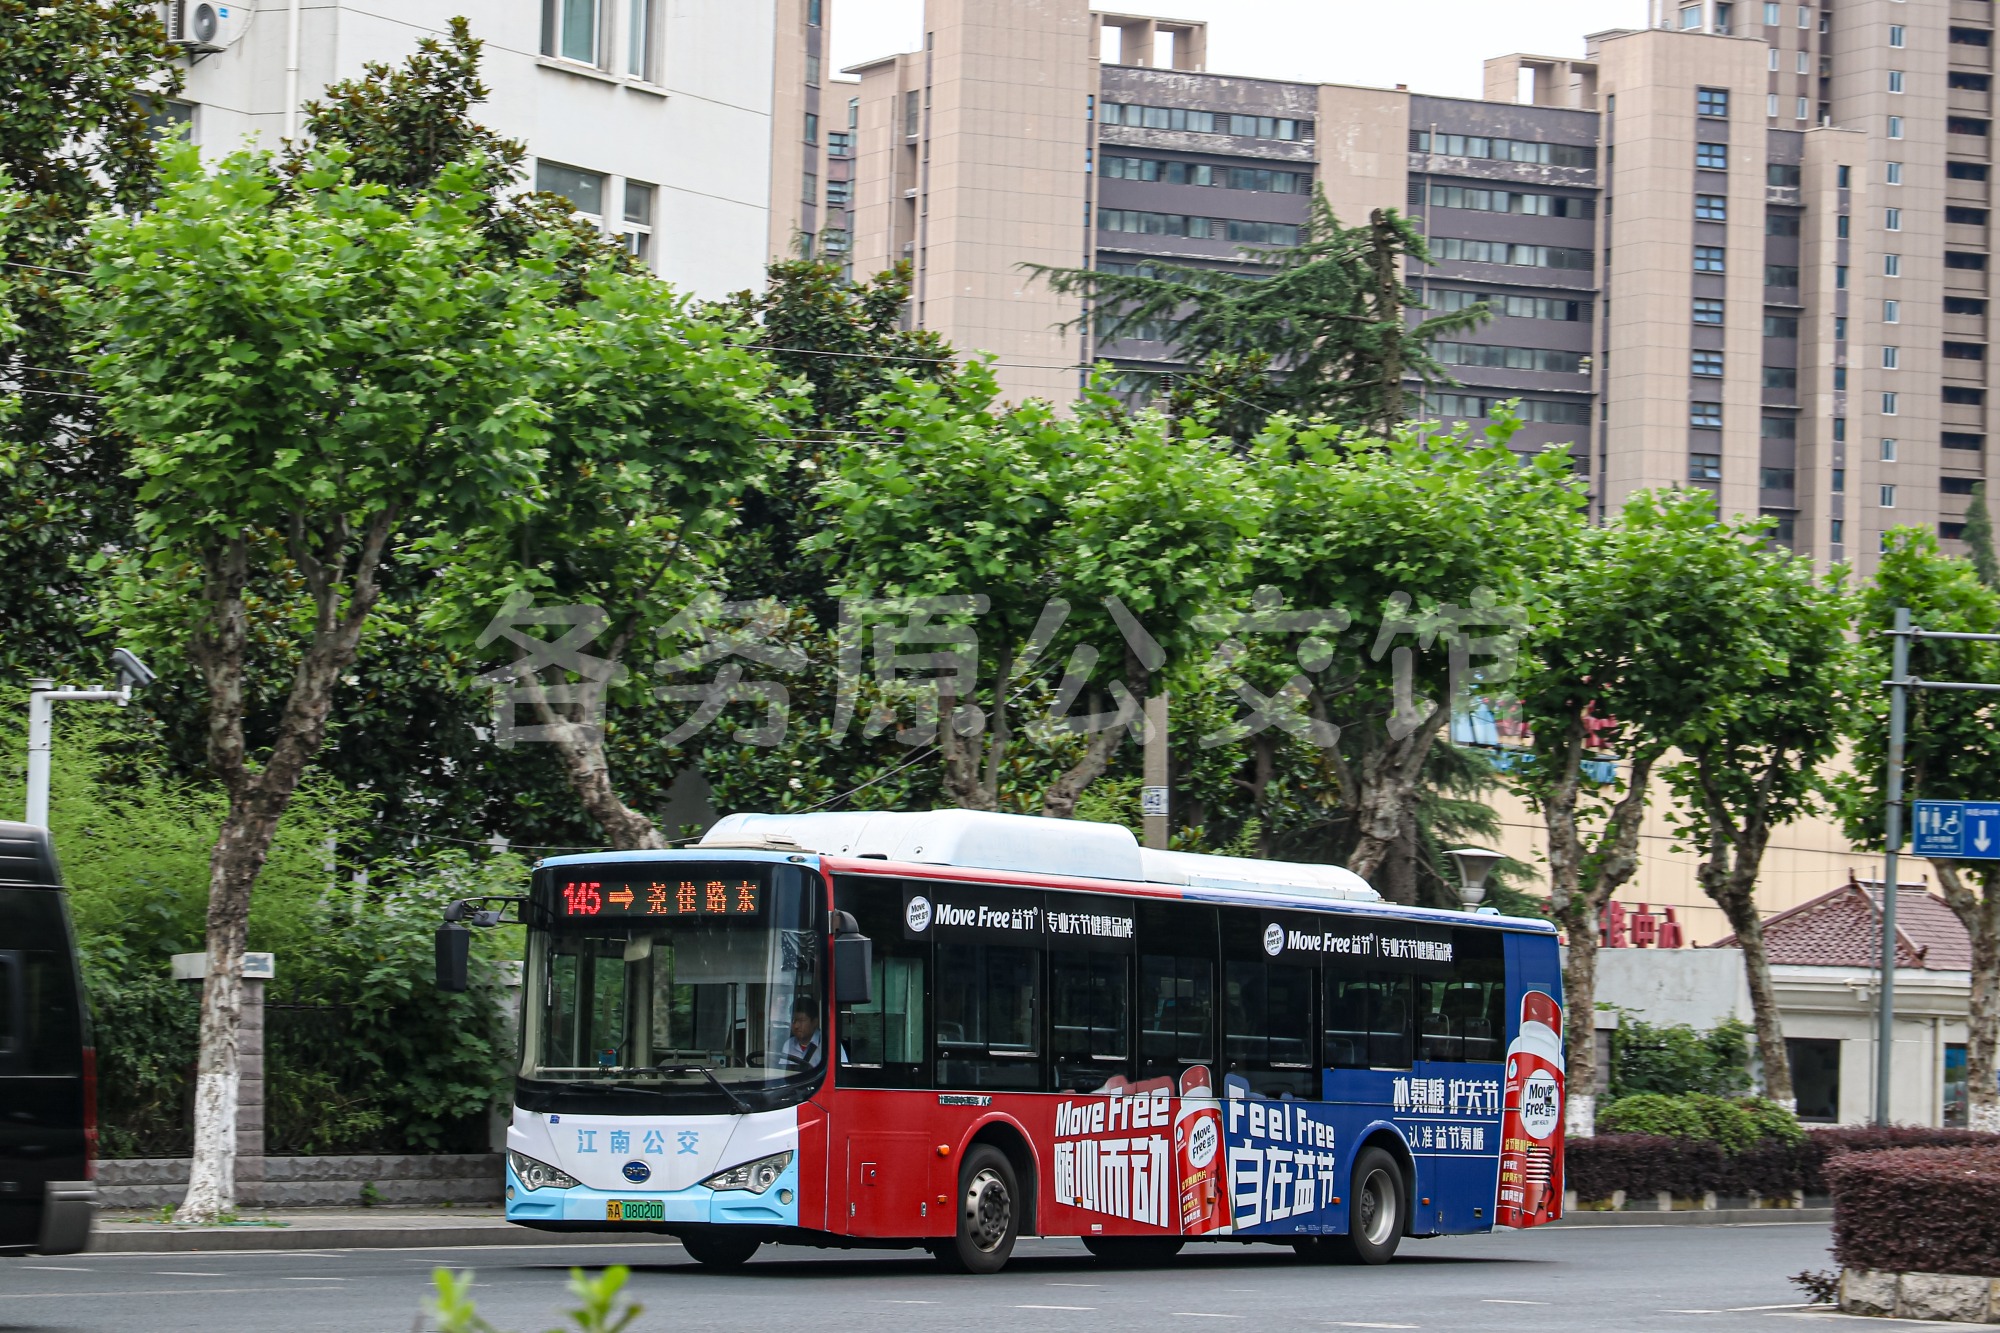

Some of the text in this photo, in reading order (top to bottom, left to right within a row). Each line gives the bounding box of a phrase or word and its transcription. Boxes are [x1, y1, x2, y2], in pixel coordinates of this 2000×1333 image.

[564, 881, 757, 915] 145 尧佳路东
[935, 903, 975, 925] Move
[978, 906, 1010, 928] Free
[1046, 912, 1133, 939] 专业关节健康品牌
[1287, 930, 1321, 950] Move
[1323, 932, 1350, 953] Free
[1381, 938, 1453, 962] 专业关节健康品牌
[1055, 1086, 1170, 1137] Move Free
[1393, 1077, 1499, 1116] 补氨糖 护关节
[1525, 1102, 1544, 1118] Free
[1228, 1084, 1335, 1149] Feel Free
[577, 1129, 699, 1155] 江南公交
[1192, 1139, 1207, 1159] Free
[1193, 1124, 1211, 1145] Move
[1409, 1125, 1484, 1150] 认准 益节氨糖
[1054, 1134, 1169, 1228] 随心而动
[1229, 1138, 1335, 1229] 自在益节
[625, 1203, 663, 1218] 08020D
